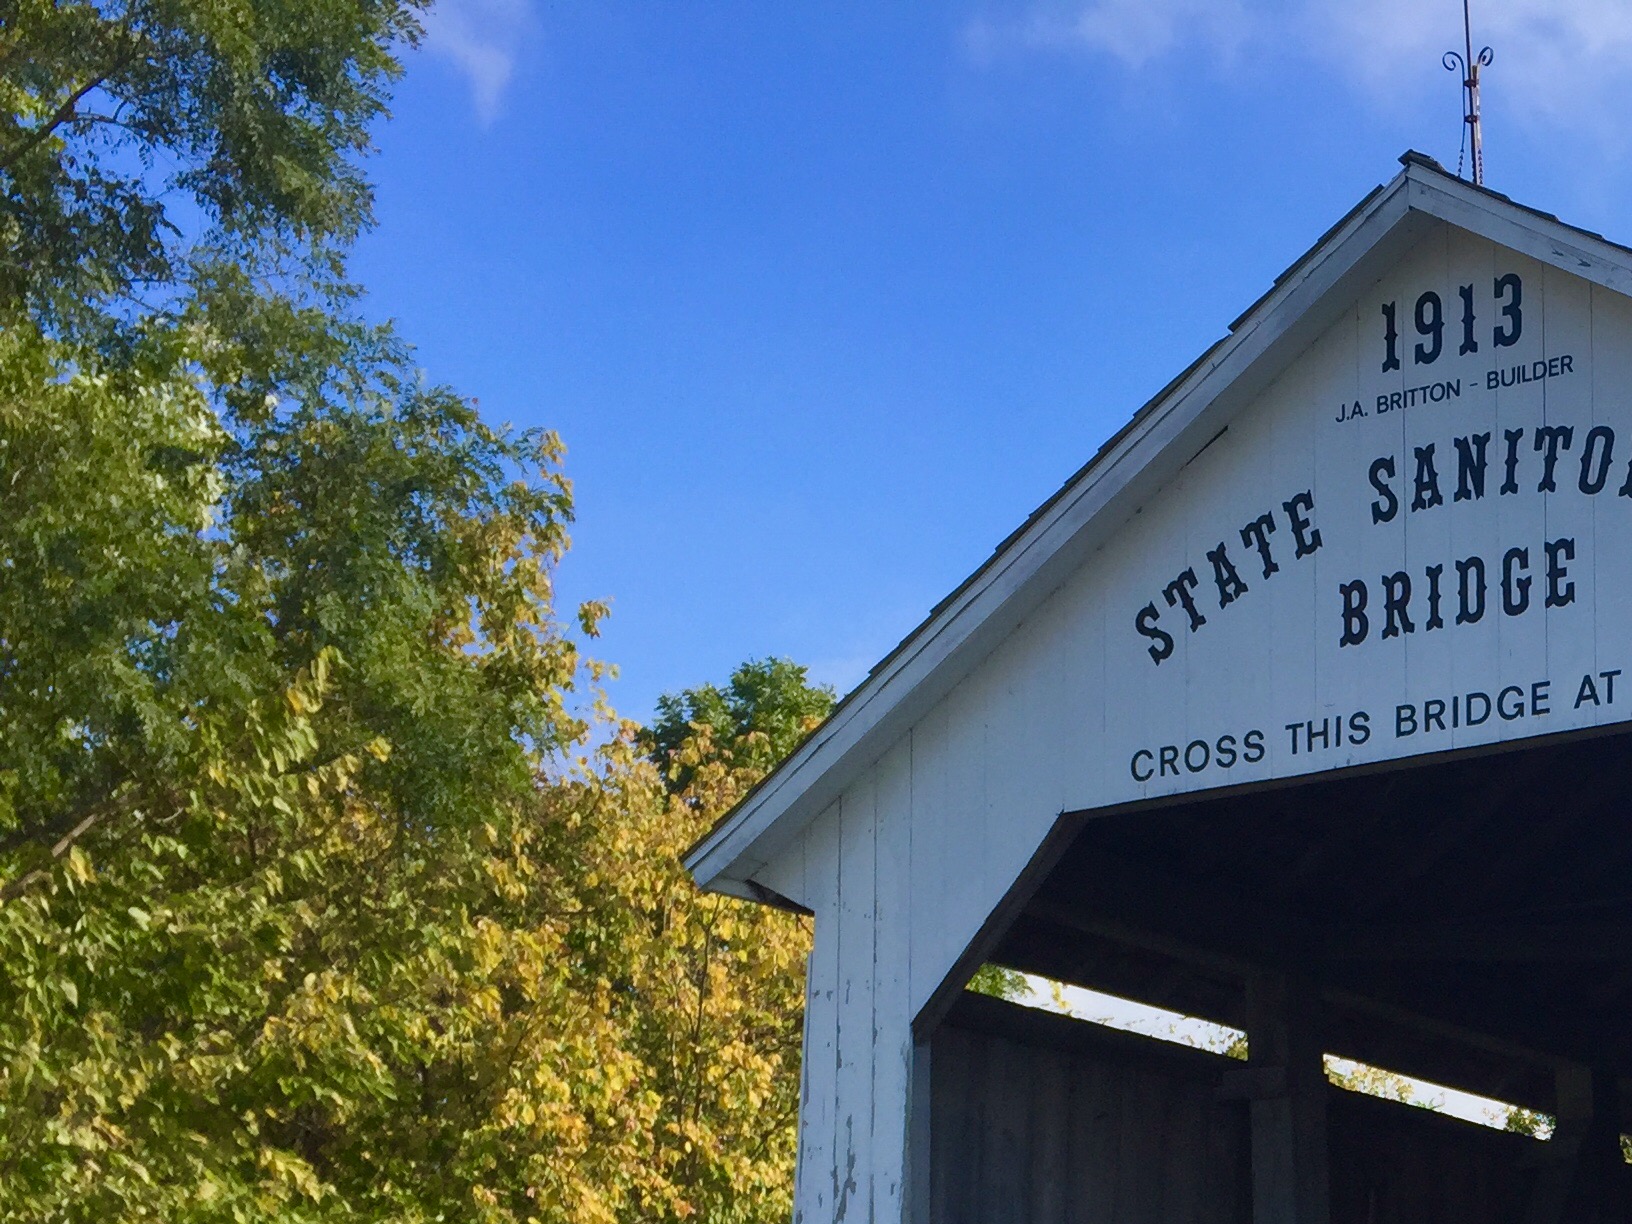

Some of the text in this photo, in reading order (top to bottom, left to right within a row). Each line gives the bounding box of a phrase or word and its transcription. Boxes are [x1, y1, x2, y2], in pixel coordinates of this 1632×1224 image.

[1381, 273, 1522, 373] 1913
[1335, 401, 1368, 422] J.A.
[1376, 379, 1461, 414] BRITTON
[1486, 355, 1574, 390] BUILDER
[1135, 489, 1323, 665] STATE
[1339, 538, 1576, 648] BRIDGE
[1130, 729, 1266, 782] CROSS
[1285, 711, 1371, 755] THIS
[1395, 681, 1551, 738] BRIDGE
[1574, 669, 1623, 710] AT
